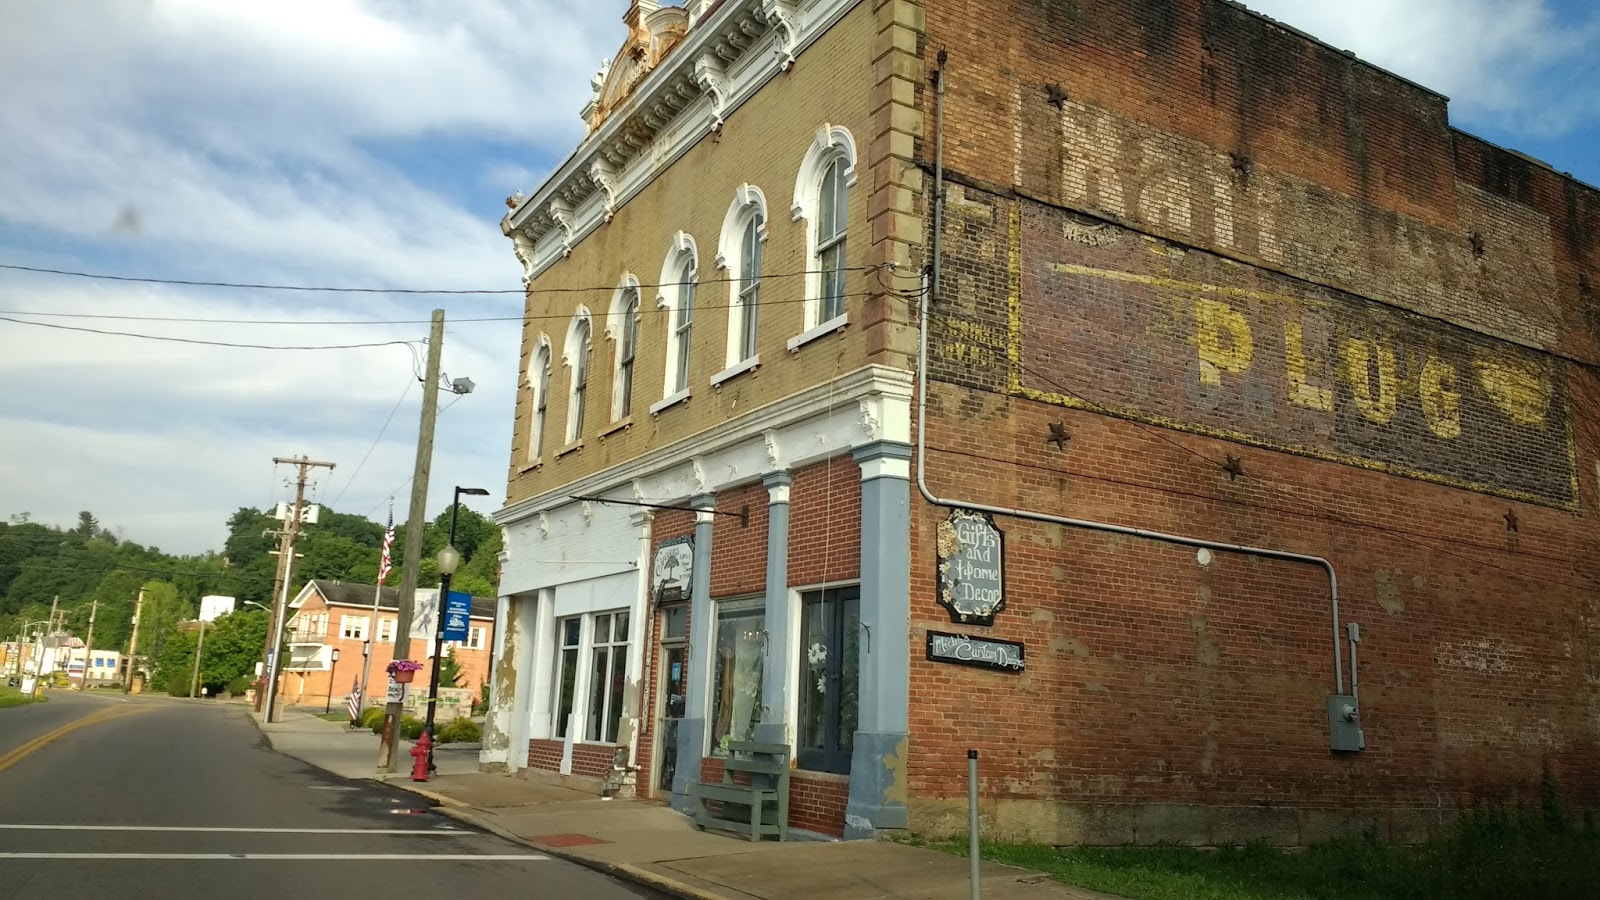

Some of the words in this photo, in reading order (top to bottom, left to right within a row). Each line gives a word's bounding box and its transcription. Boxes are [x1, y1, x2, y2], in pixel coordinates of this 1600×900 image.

[957, 523, 1000, 548] Gifts
[966, 547, 991, 563] and
[956, 561, 998, 581] Home
[962, 583, 1000, 602] Decor
[955, 642, 998, 661] Custom
